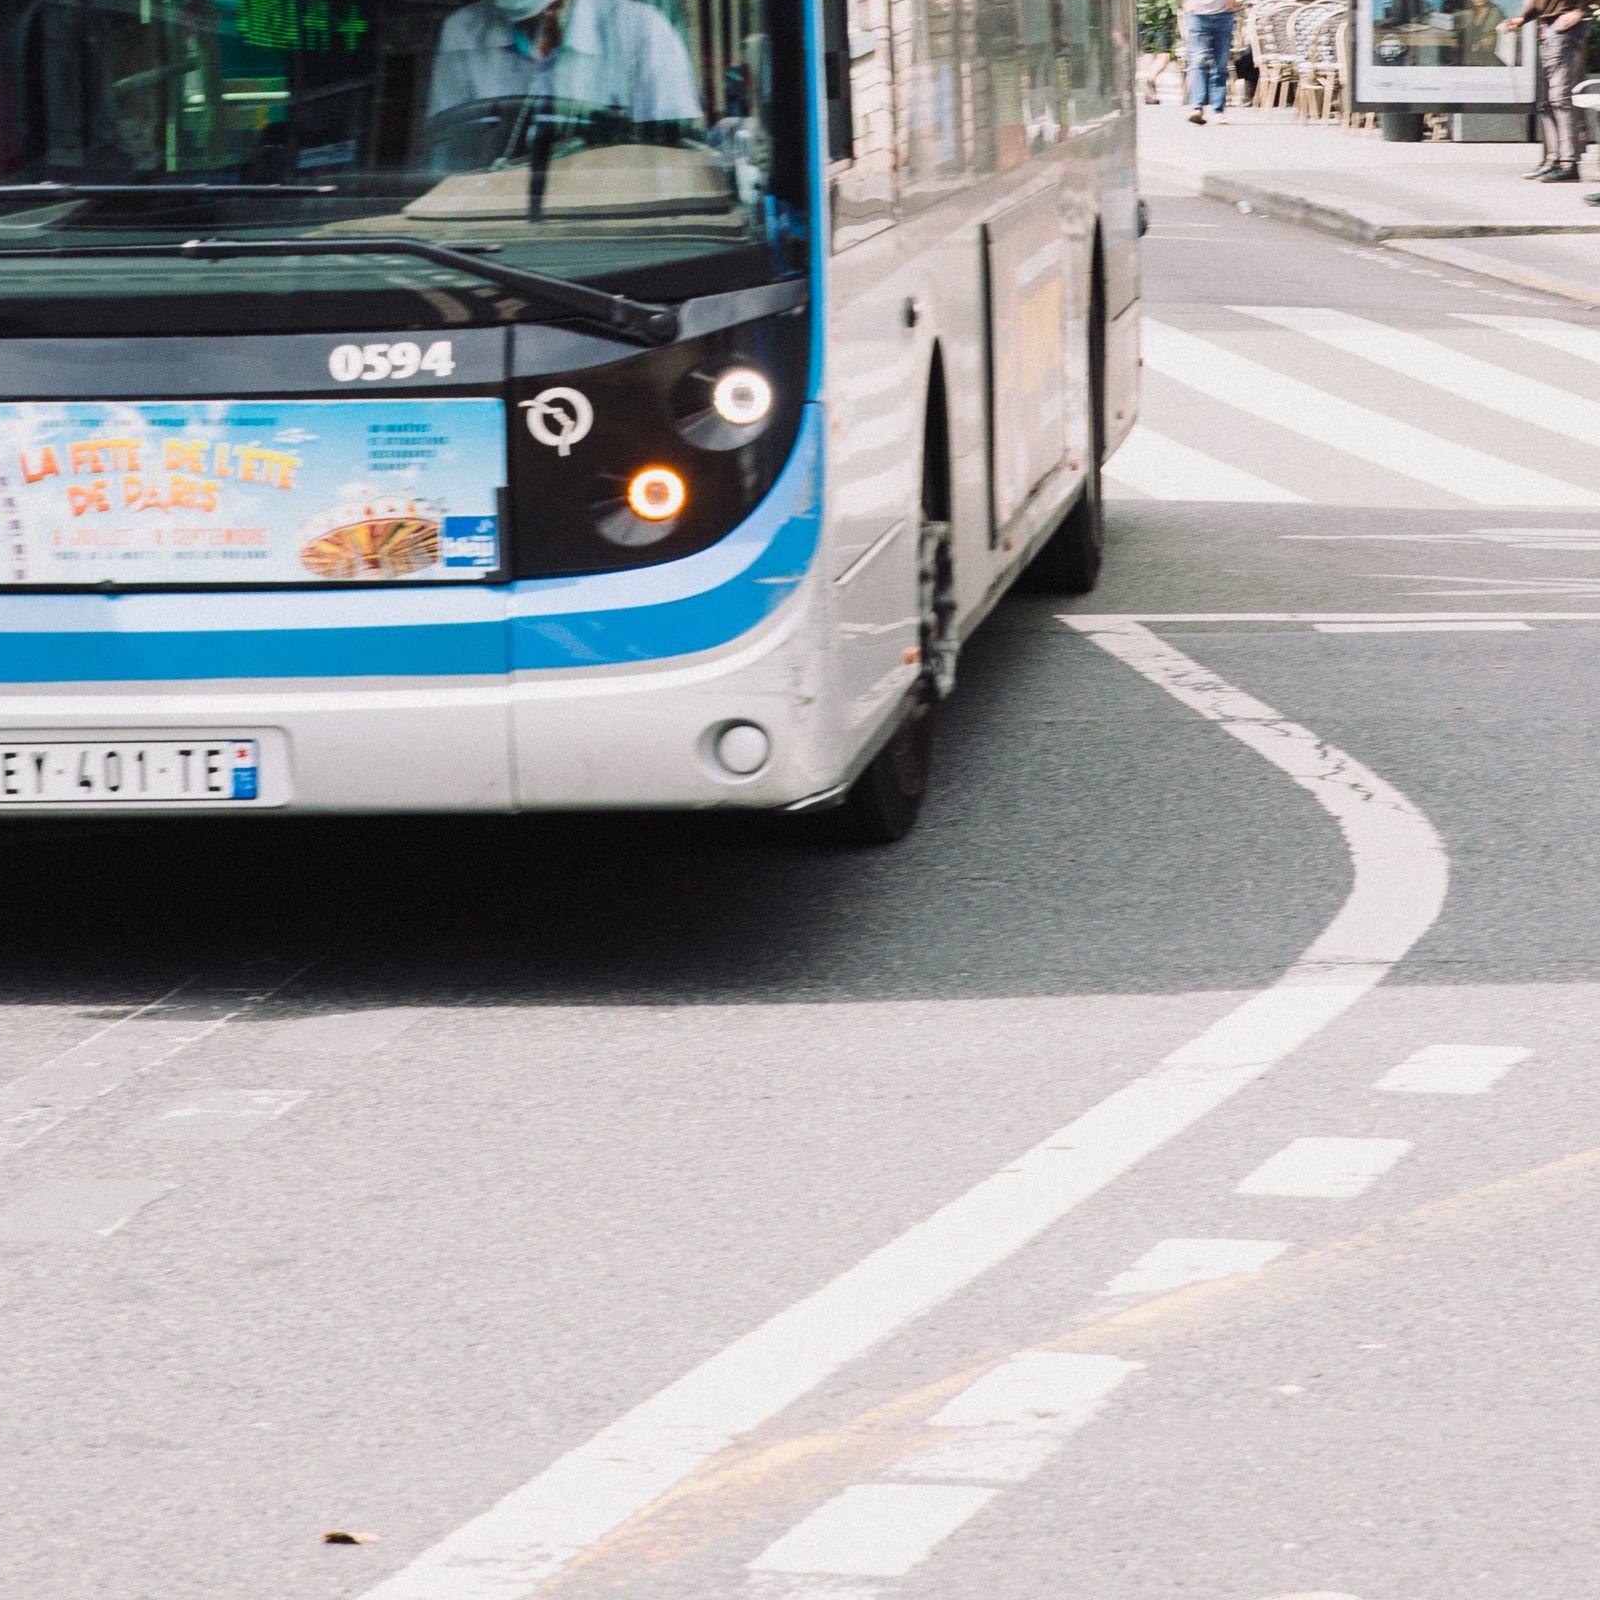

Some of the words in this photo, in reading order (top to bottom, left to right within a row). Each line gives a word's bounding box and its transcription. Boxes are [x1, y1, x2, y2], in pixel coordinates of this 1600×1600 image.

[328, 340, 456, 383] 0594
[19, 447, 61, 484] LA
[67, 434, 143, 475] FÊTE
[163, 436, 210, 473] DE
[66, 479, 111, 517] DE
[120, 473, 222, 515] PARIS
[2, 748, 224, 794] EY-401-TE
